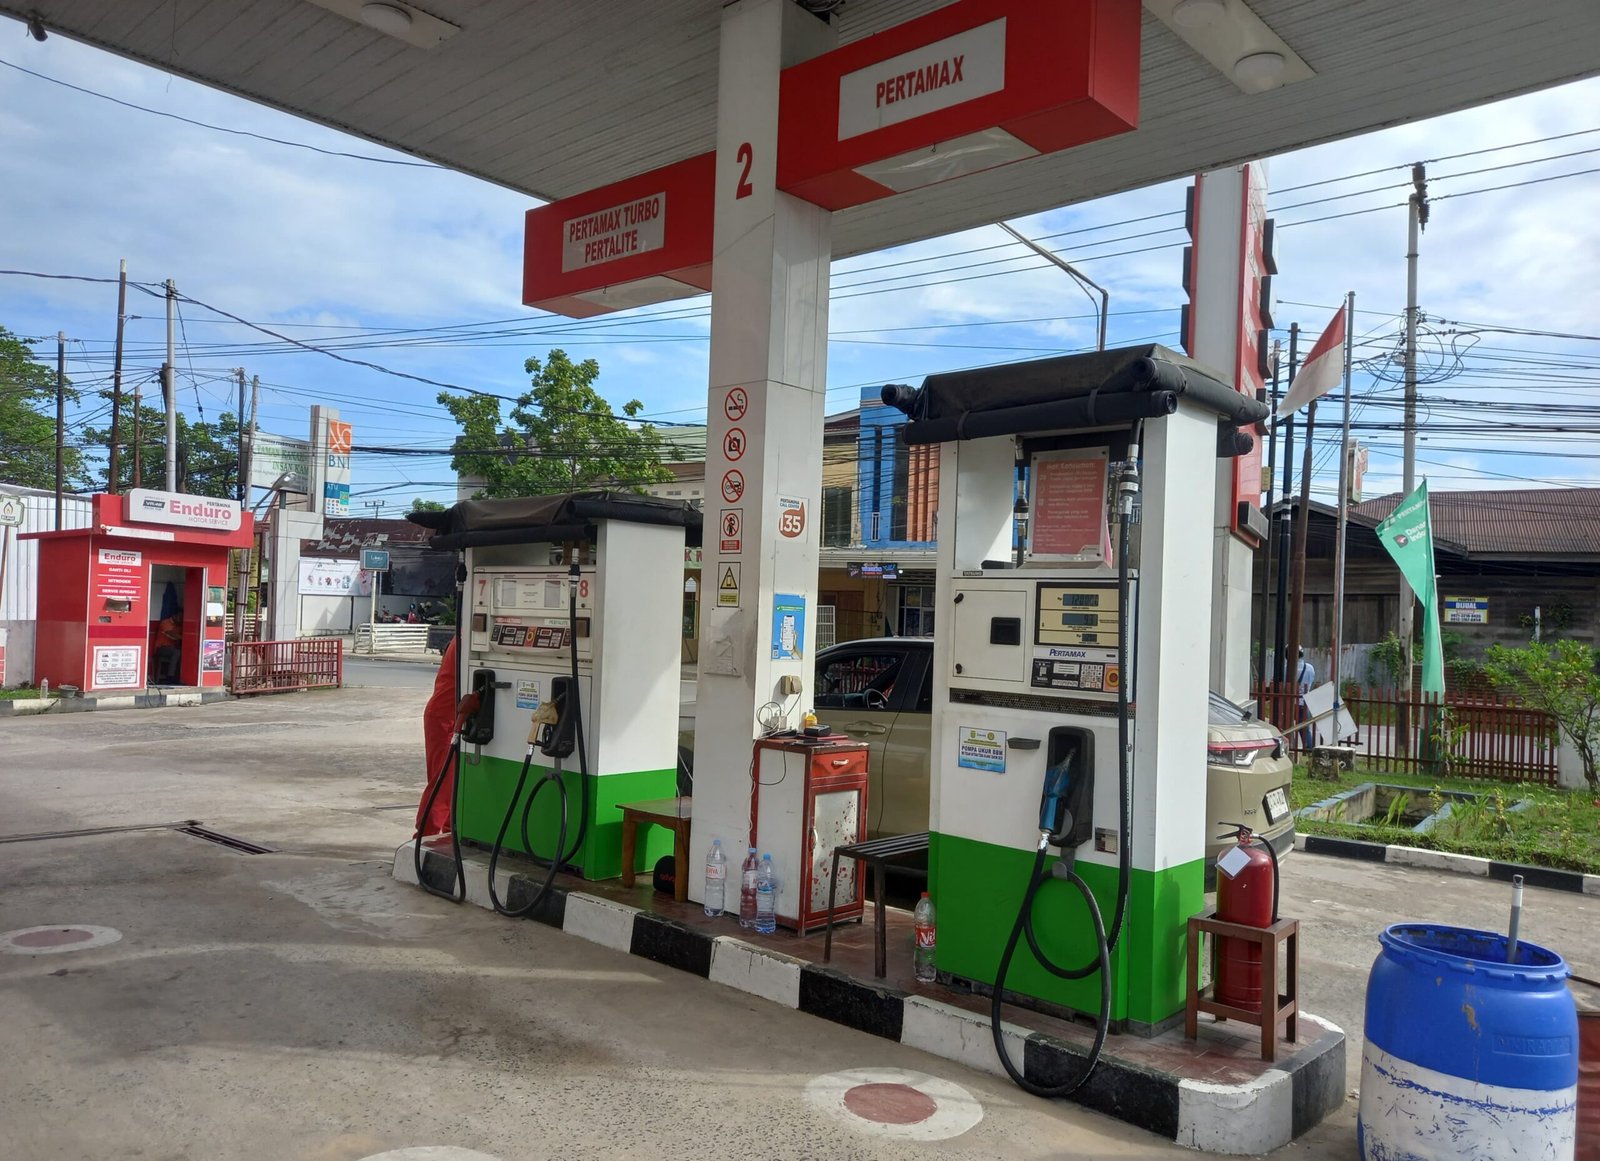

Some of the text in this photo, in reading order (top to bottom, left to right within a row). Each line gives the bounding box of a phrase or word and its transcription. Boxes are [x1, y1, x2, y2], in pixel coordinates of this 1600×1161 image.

[876, 55, 964, 108] PERTAMAX
[736, 142, 753, 200] 2
[569, 197, 660, 243] PERTAMAX TURBO
[584, 229, 638, 263] PERTALITE
[328, 454, 350, 470] BNI
[169, 499, 232, 520] Enduro
[206, 501, 231, 509] PERTAMINA
[209, 518, 228, 526] SERVICE
[780, 513, 801, 533] 135
[104, 552, 136, 562] Enduro
[478, 579, 487, 597] 7
[579, 579, 589, 598] 8
[1049, 648, 1086, 658] PERTAMAX
